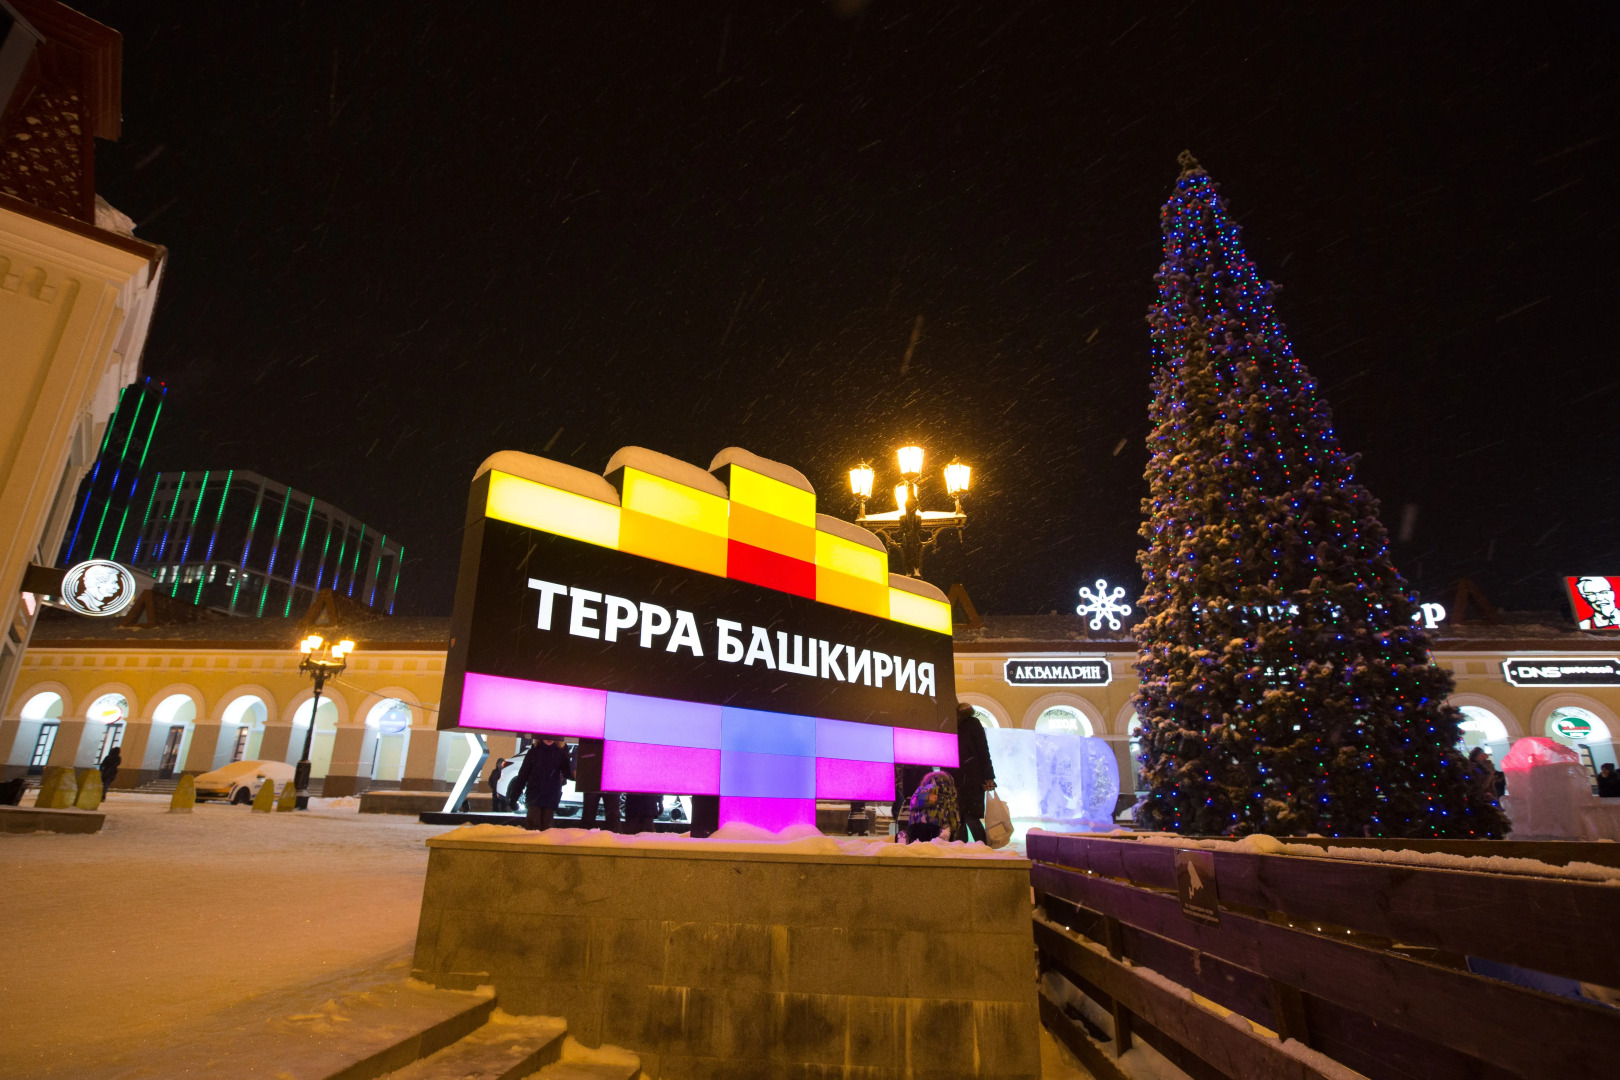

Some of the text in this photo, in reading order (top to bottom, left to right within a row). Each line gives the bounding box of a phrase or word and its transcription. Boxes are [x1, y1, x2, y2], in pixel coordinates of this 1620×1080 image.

[528, 578, 936, 697] ТЕРРА БАШКИРИЯ
[1015, 666, 1101, 679] АКВАМАРИН
[1517, 667, 1561, 678] DNS
